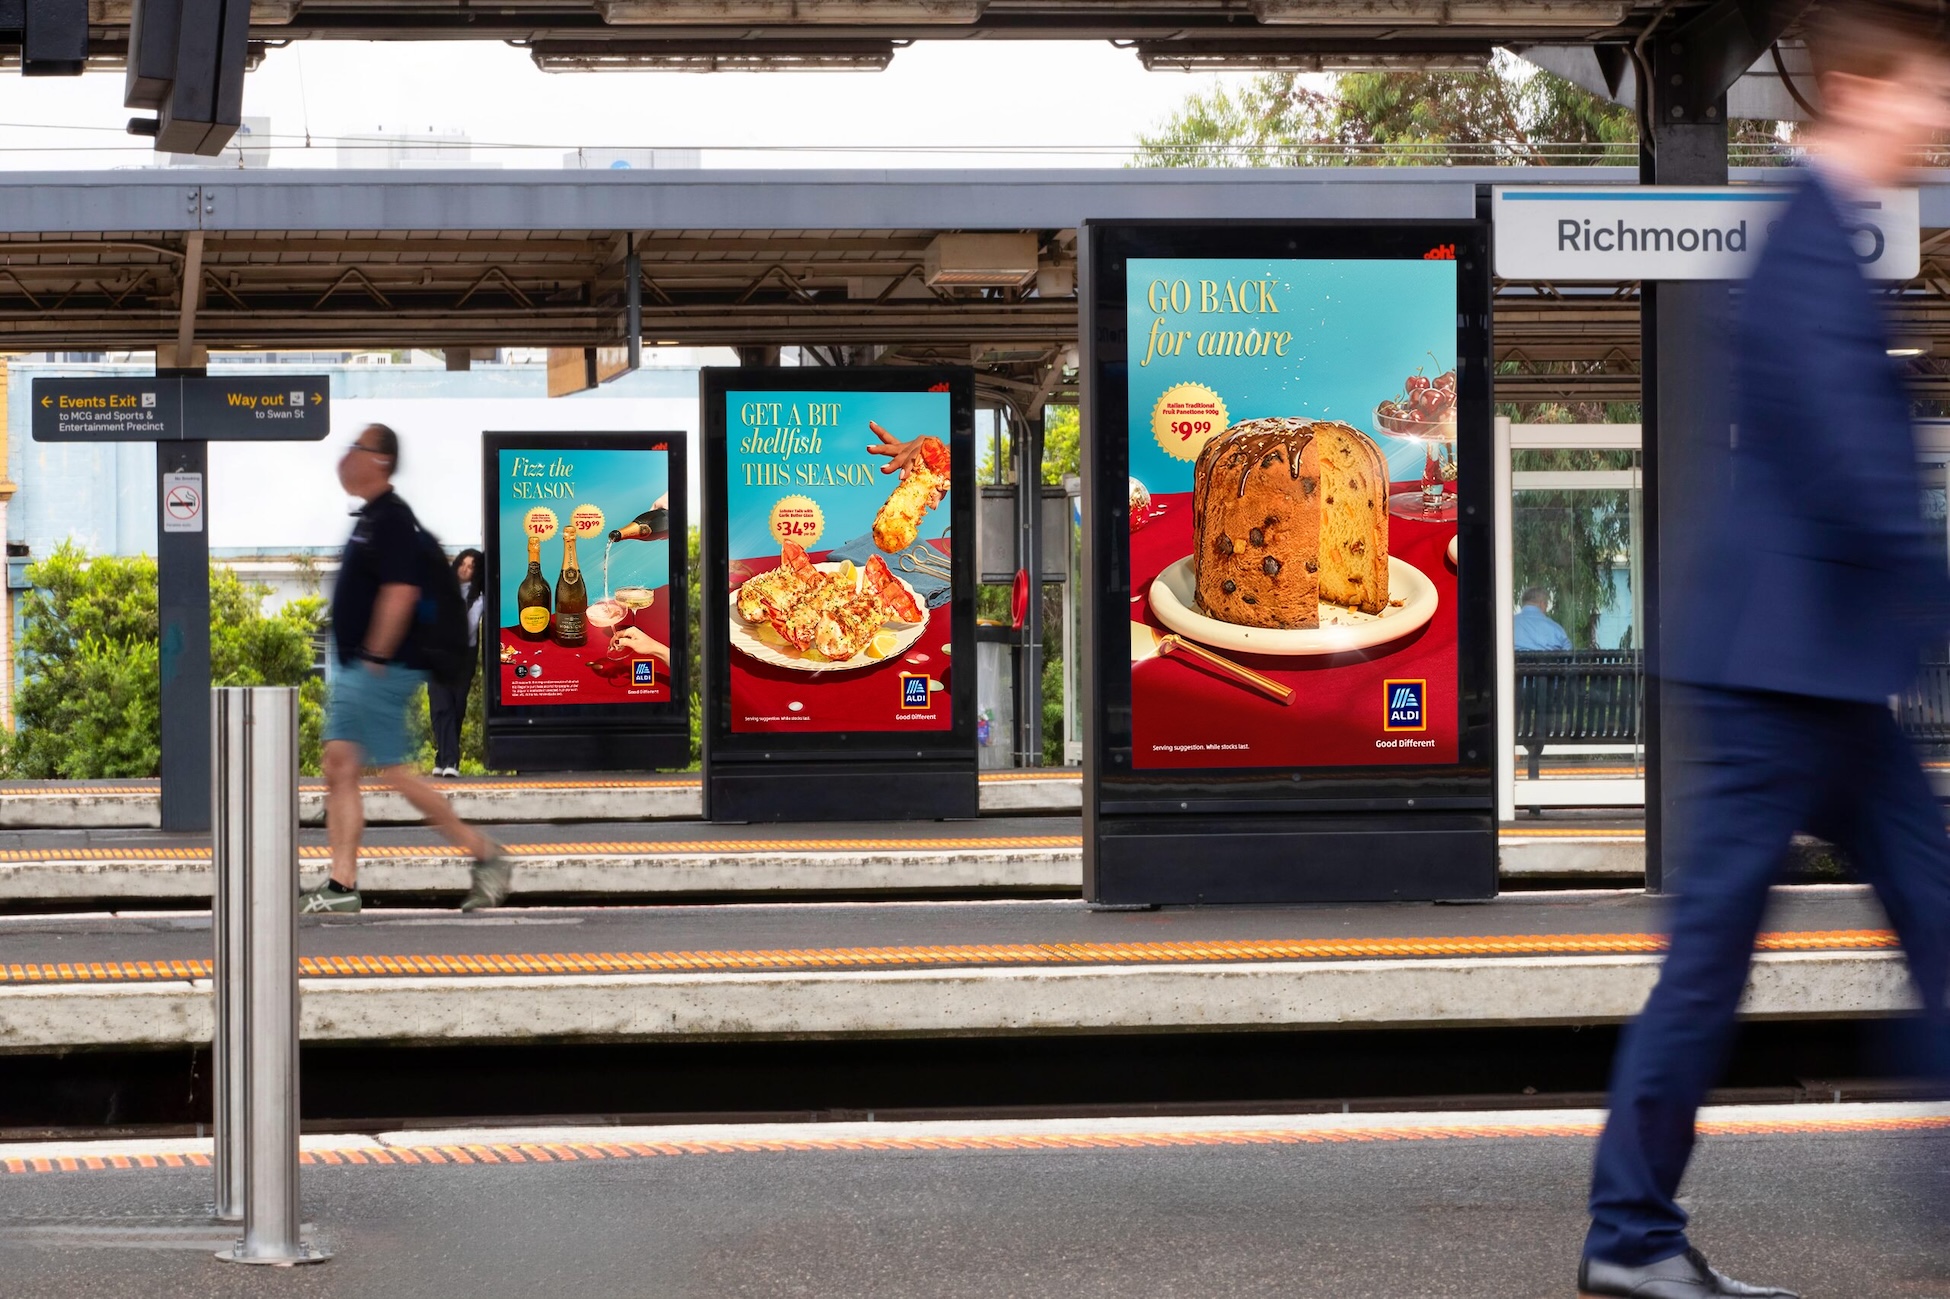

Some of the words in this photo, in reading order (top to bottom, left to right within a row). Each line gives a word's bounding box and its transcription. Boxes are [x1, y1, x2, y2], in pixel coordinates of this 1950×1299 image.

[1557, 219, 1747, 252] Richmond
[1147, 278, 1191, 314] GO
[1199, 278, 1280, 314] BACK
[1140, 317, 1192, 367] for
[1197, 329, 1292, 357] amore
[59, 394, 106, 408] Events
[109, 394, 137, 408] Exit
[227, 393, 259, 408] Way
[261, 393, 284, 406] out
[59, 411, 69, 421] to
[71, 411, 93, 421] MCG
[94, 411, 111, 421] and
[113, 411, 144, 422] Sports
[146, 411, 154, 420] &
[255, 410, 266, 419] to
[267, 410, 293, 419] Swan
[294, 410, 305, 419] St
[740, 402, 782, 426] GET
[788, 403, 803, 426] A
[808, 403, 842, 427] BIT
[59, 422, 125, 432] Entertainment
[126, 422, 164, 431] Precinct
[740, 427, 822, 461] shellfish
[511, 457, 546, 477] Fizz
[549, 457, 574, 477] the
[742, 463, 791, 486] THIS
[796, 463, 875, 487] SEASON
[512, 481, 576, 499] SEASON
[906, 694, 926, 702] ALDI
[1391, 710, 1419, 720] ALDI
[1152, 744, 1173, 752] Serving
[1173, 743, 1205, 752] suggestion.
[1375, 739, 1398, 748] Good
[1398, 738, 1436, 748] Different
